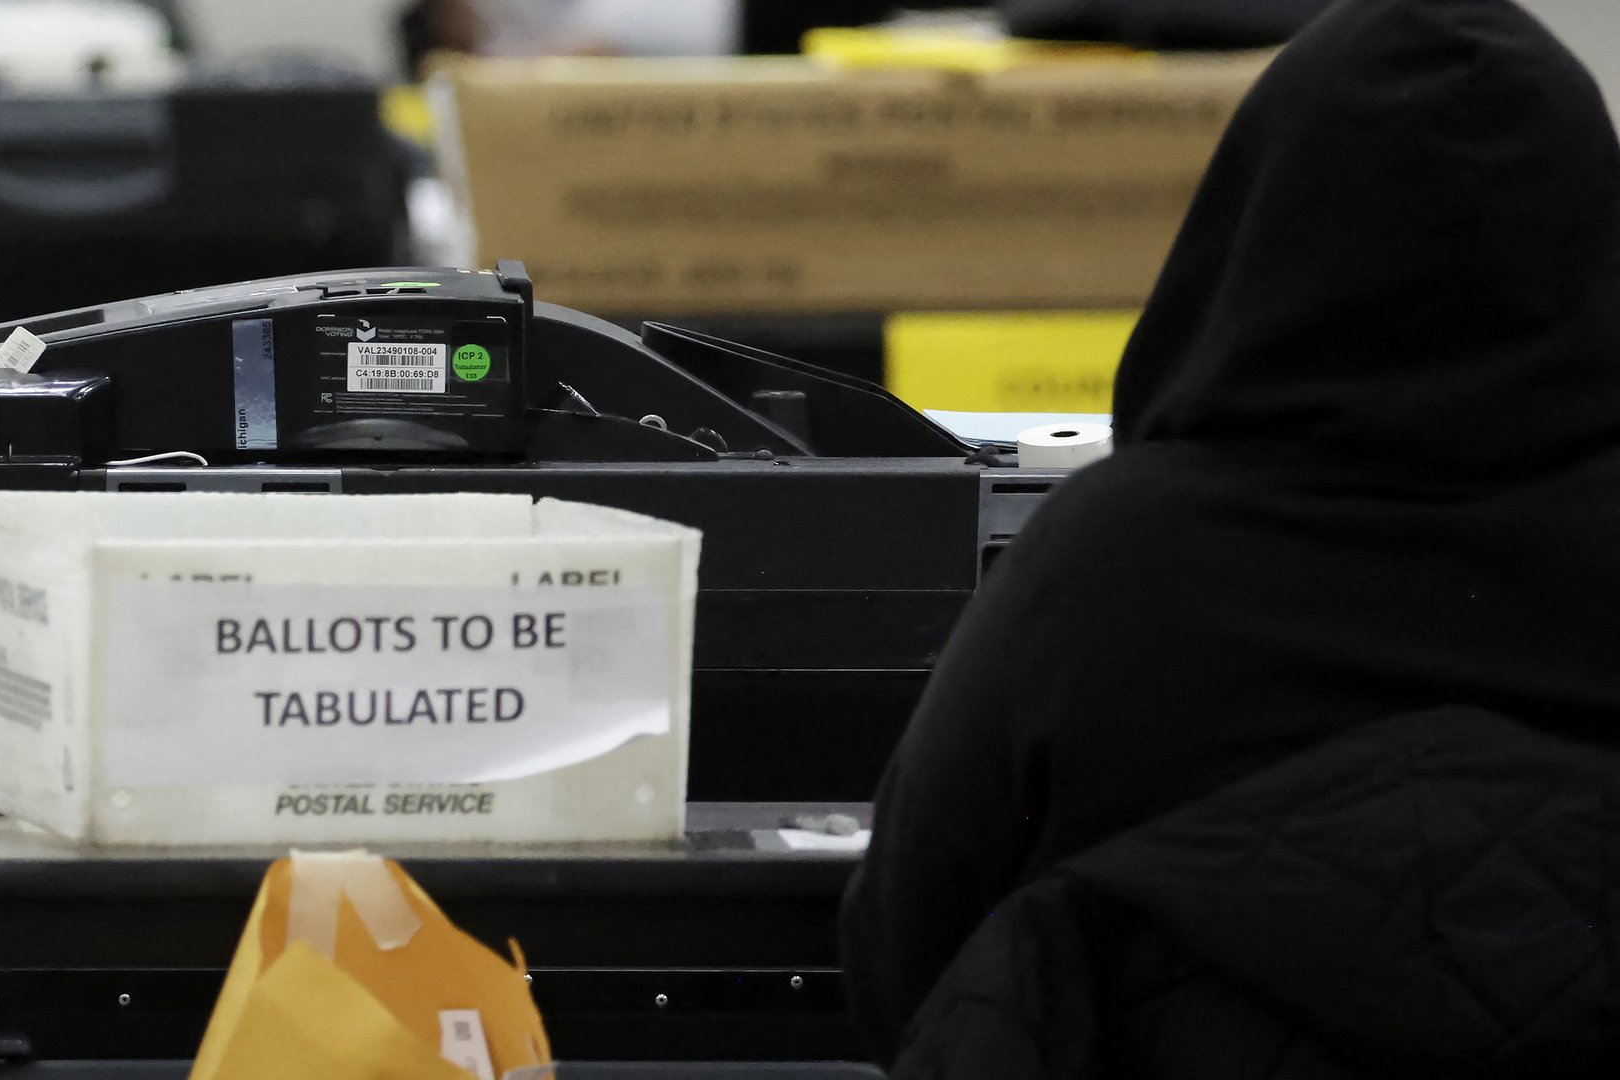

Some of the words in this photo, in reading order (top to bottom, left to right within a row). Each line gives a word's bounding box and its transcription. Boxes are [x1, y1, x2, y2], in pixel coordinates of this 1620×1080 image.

[358, 347, 438, 356] VAL23490108-004
[458, 352, 476, 360] ICP
[478, 352, 484, 360] 2
[356, 369, 439, 378] C4:19:8B:00:69:D8
[216, 616, 417, 654] BALLOTS
[433, 615, 495, 652] TO
[512, 612, 567, 649] BE
[254, 687, 526, 727] TABULATED
[275, 794, 376, 816] POSTAL
[382, 792, 495, 815] SERVICE
